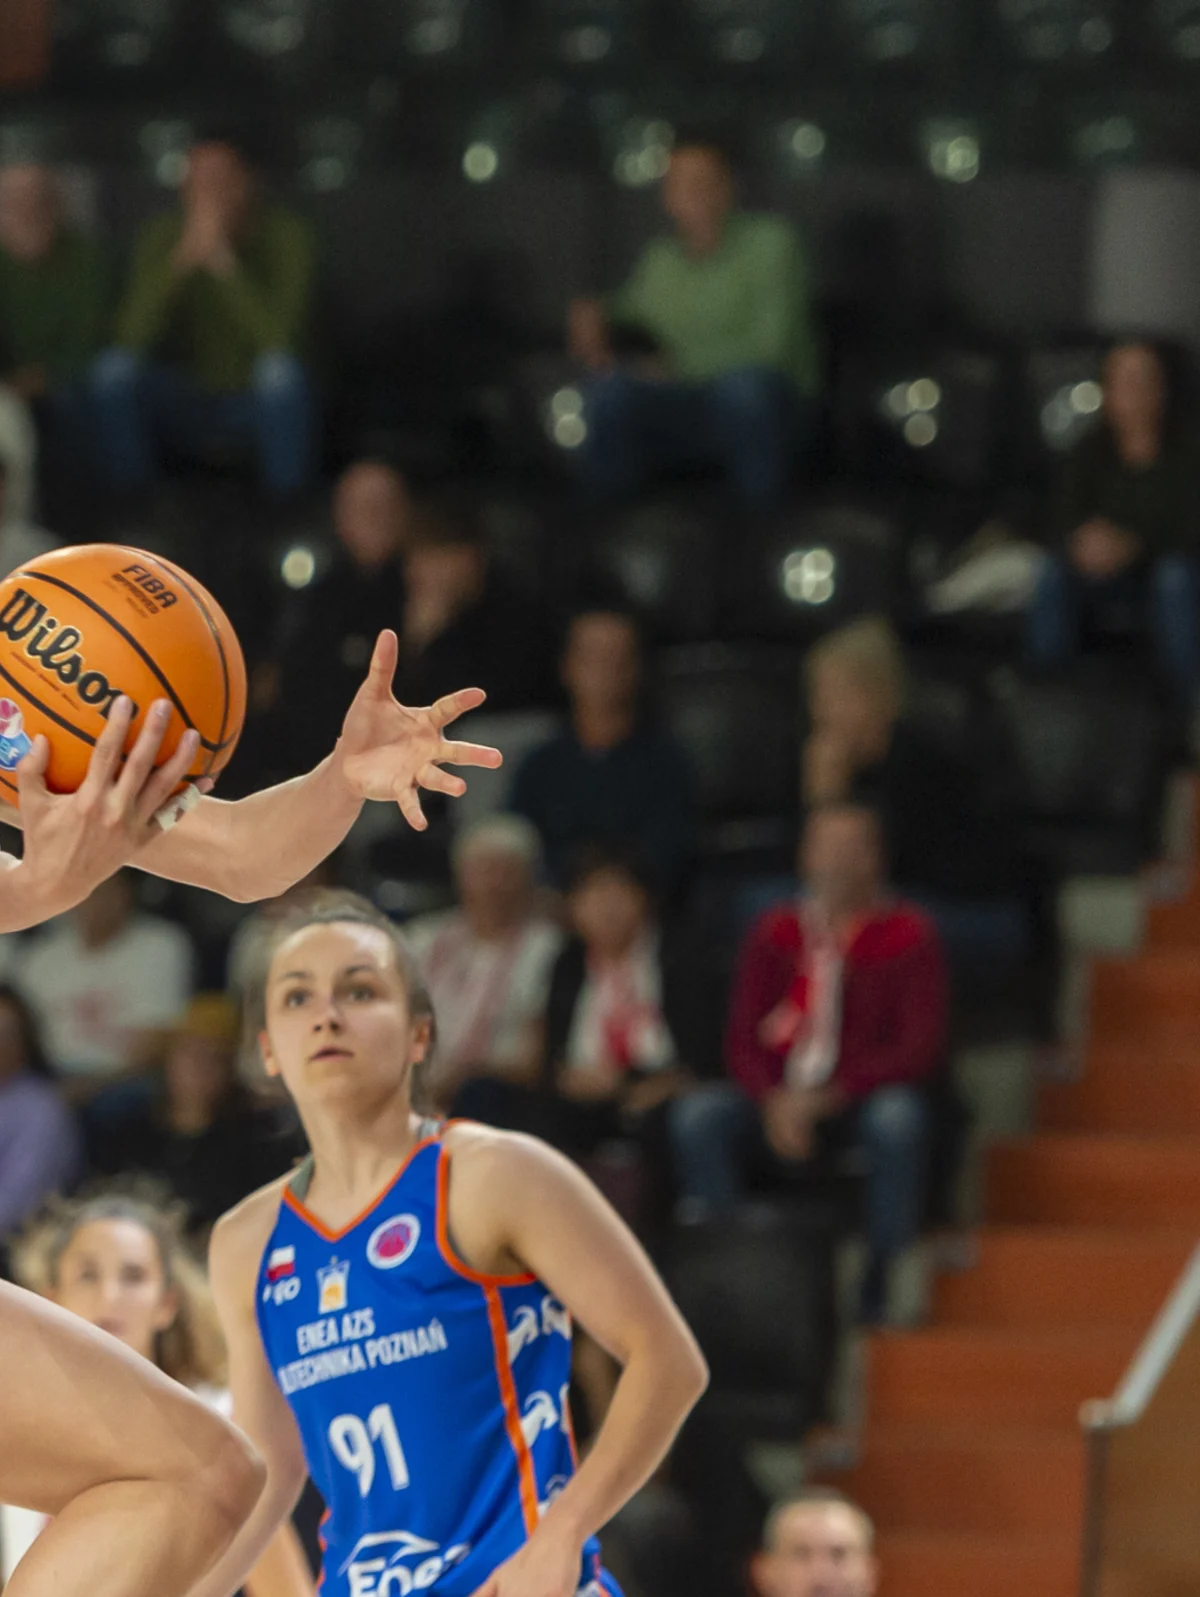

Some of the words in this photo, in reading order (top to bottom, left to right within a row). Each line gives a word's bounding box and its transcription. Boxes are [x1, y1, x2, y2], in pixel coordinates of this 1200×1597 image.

[121, 564, 178, 608] FIBA
[296, 1317, 340, 1356] ENEA
[341, 1306, 375, 1342] AZS
[365, 1316, 448, 1369] POZNAŃ
[329, 1403, 409, 1498] 91
